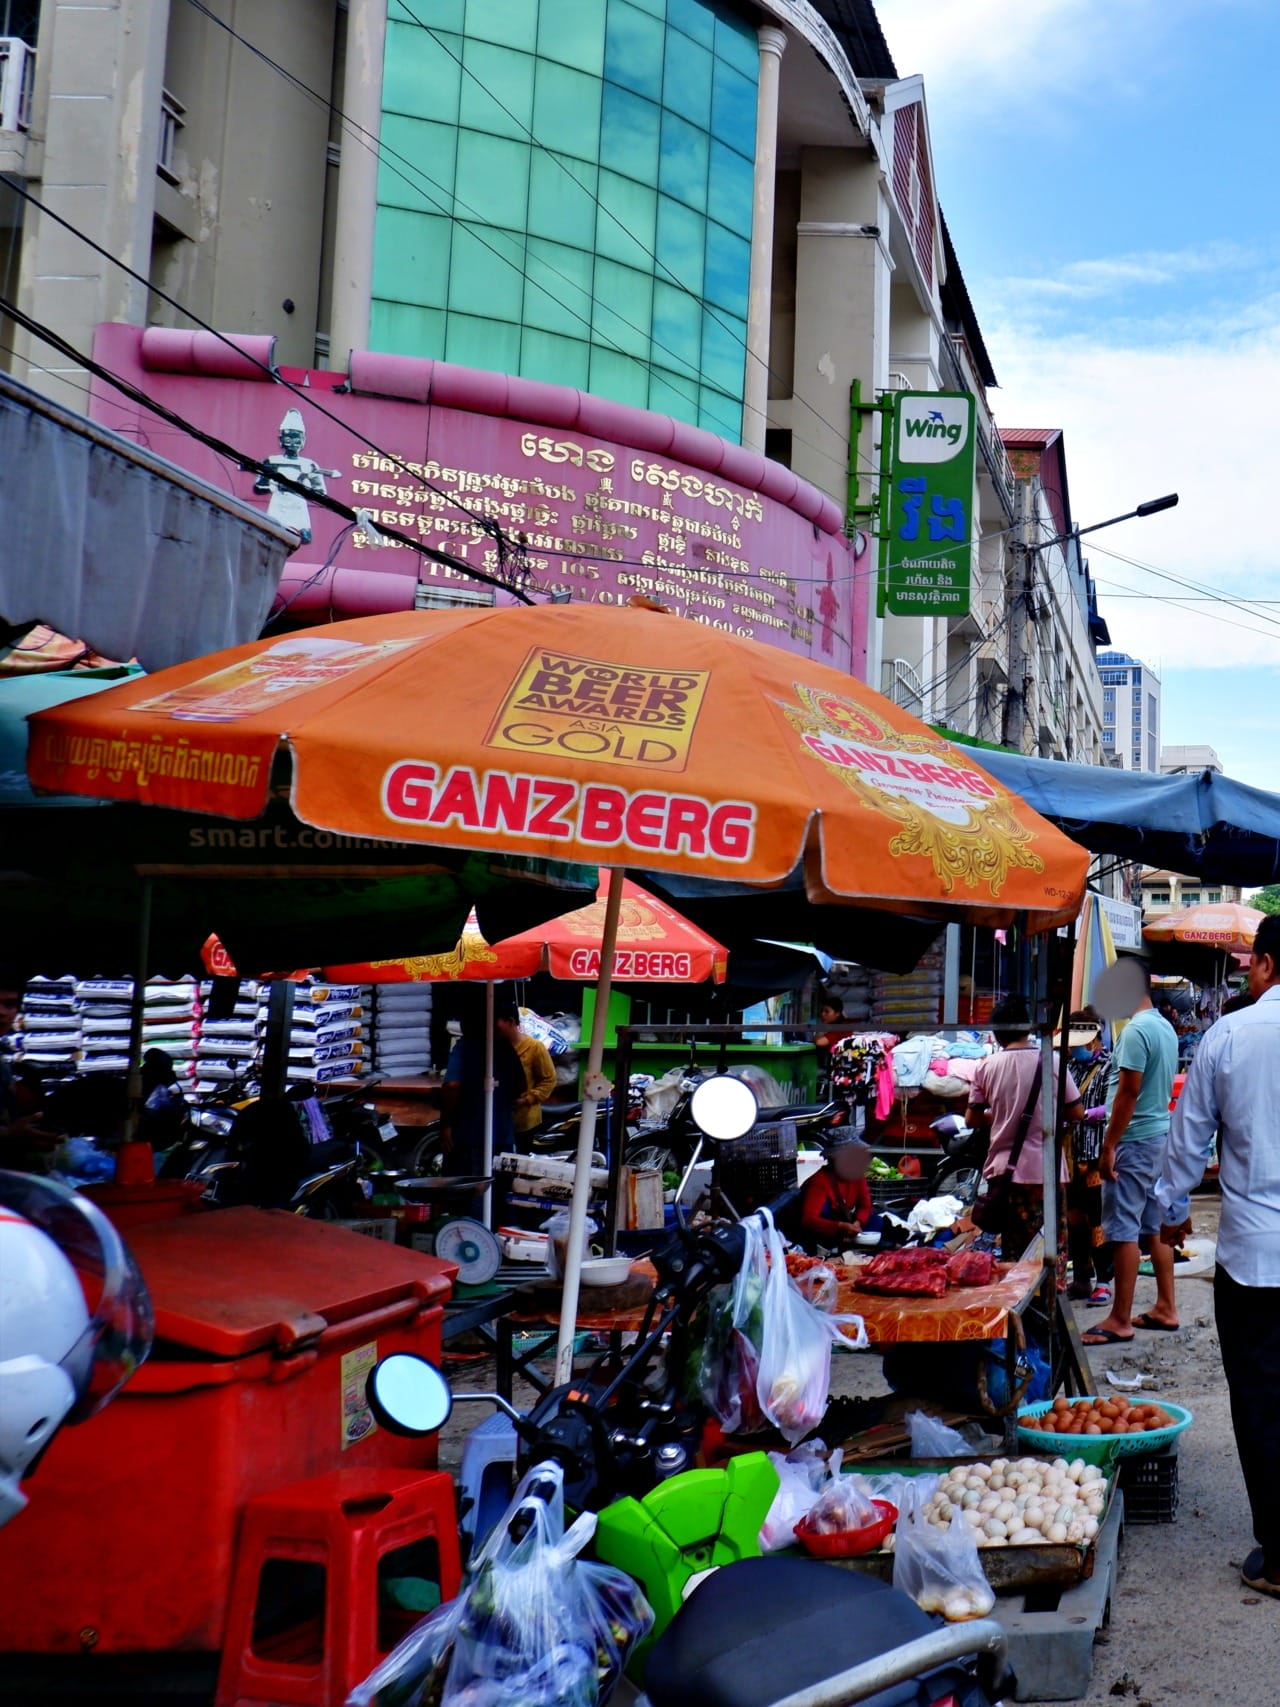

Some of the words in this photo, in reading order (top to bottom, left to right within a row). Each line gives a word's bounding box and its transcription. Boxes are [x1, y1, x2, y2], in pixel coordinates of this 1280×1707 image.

[905, 418, 962, 446] Wing
[560, 560, 600, 580] 105
[736, 626, 754, 640] 62
[540, 655, 698, 690] WORLD
[529, 670, 689, 713] BEER
[517, 693, 687, 726] AWARDS
[502, 722, 677, 763] GOLD
[569, 719, 623, 735] ASIA
[804, 734, 997, 798] GANZBERG
[385, 761, 755, 860] GANZBERG
[1184, 931, 1232, 941] GANZBERG
